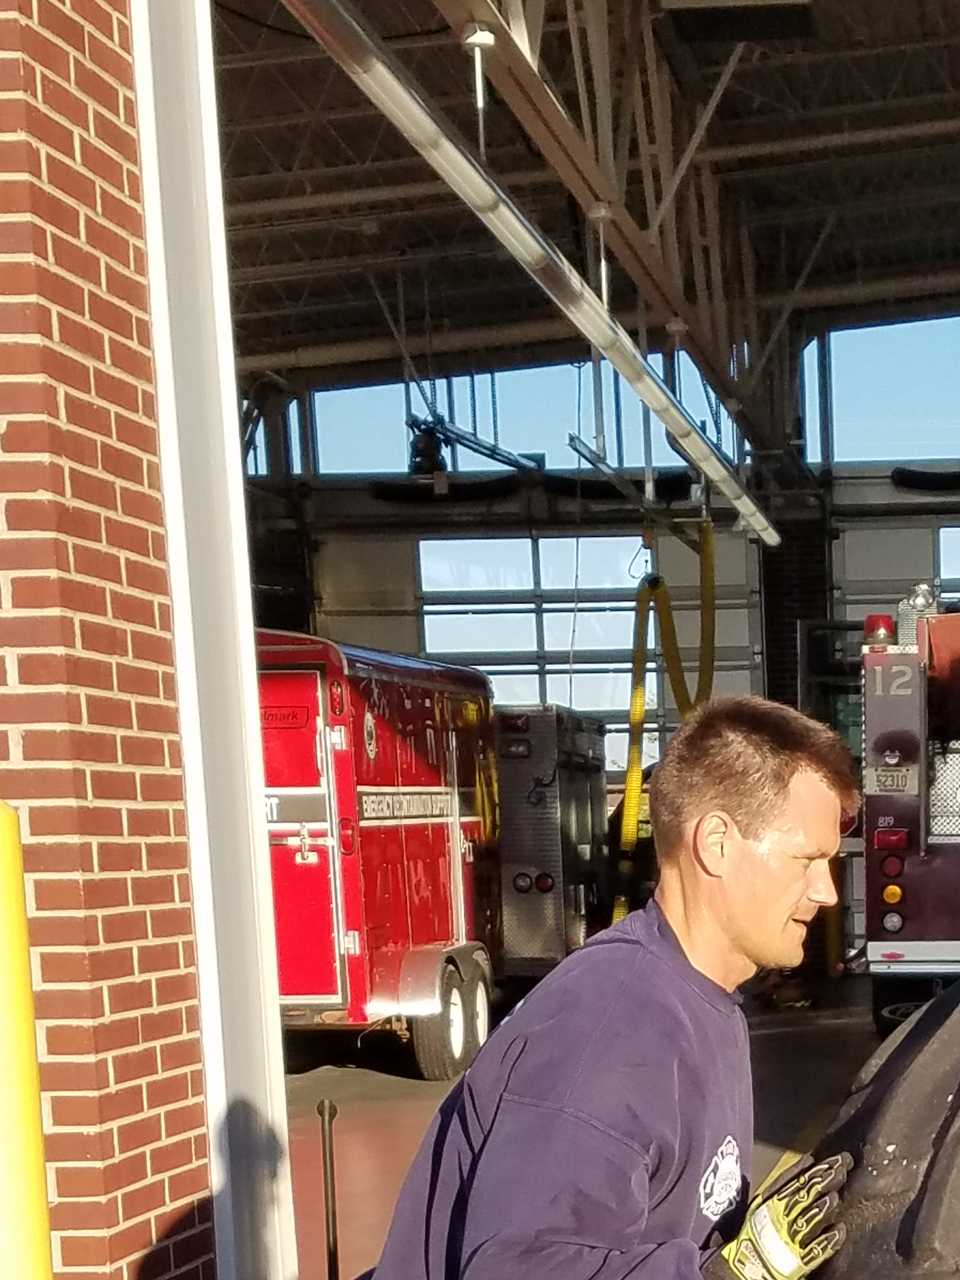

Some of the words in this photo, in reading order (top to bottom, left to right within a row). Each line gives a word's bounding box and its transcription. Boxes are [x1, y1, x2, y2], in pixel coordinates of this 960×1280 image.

[873, 665, 912, 695] 12
[876, 774, 907, 788] 52310
[878, 816, 894, 827] 819
